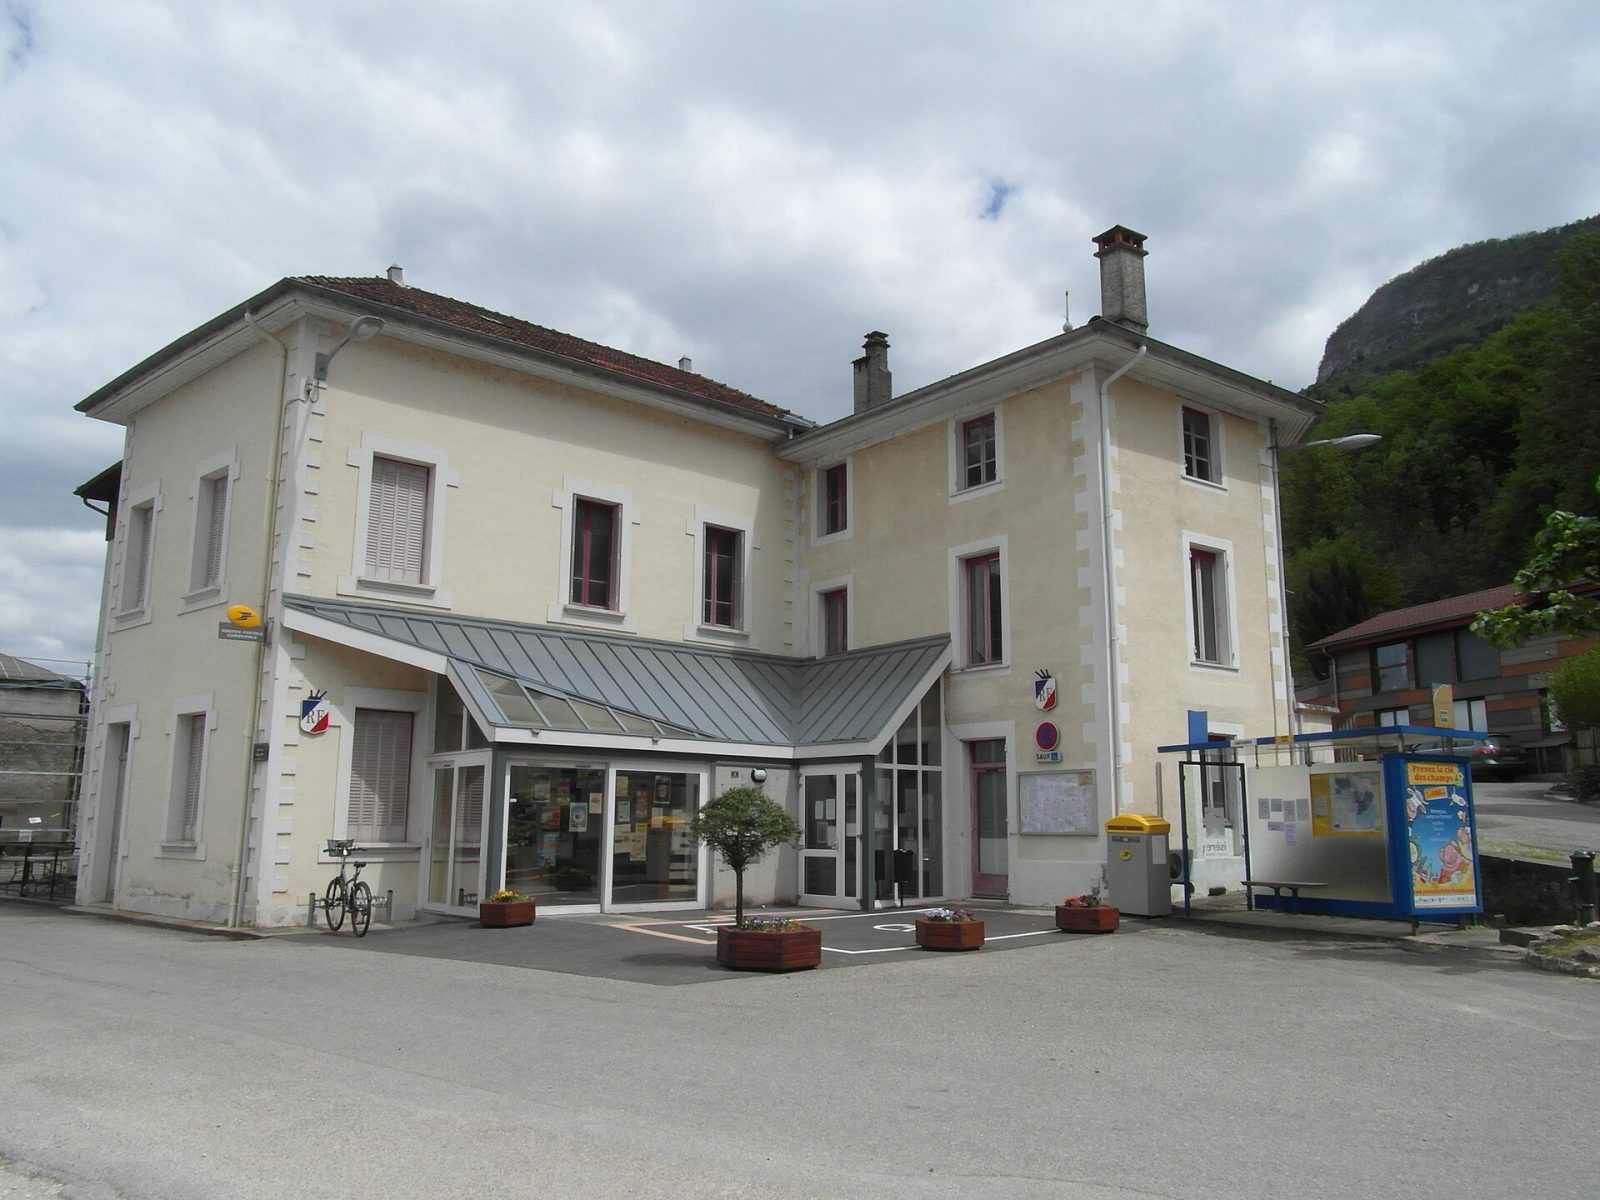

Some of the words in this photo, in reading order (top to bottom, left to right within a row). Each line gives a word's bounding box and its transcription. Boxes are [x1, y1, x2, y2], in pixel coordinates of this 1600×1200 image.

[1040, 688, 1053, 702] RF
[306, 709, 325, 724] RF
[1412, 765, 1435, 773] Prenez
[1437, 765, 1443, 773] la
[1445, 765, 1454, 774] clé
[1414, 773, 1427, 781] des
[1428, 773, 1454, 783] champs
